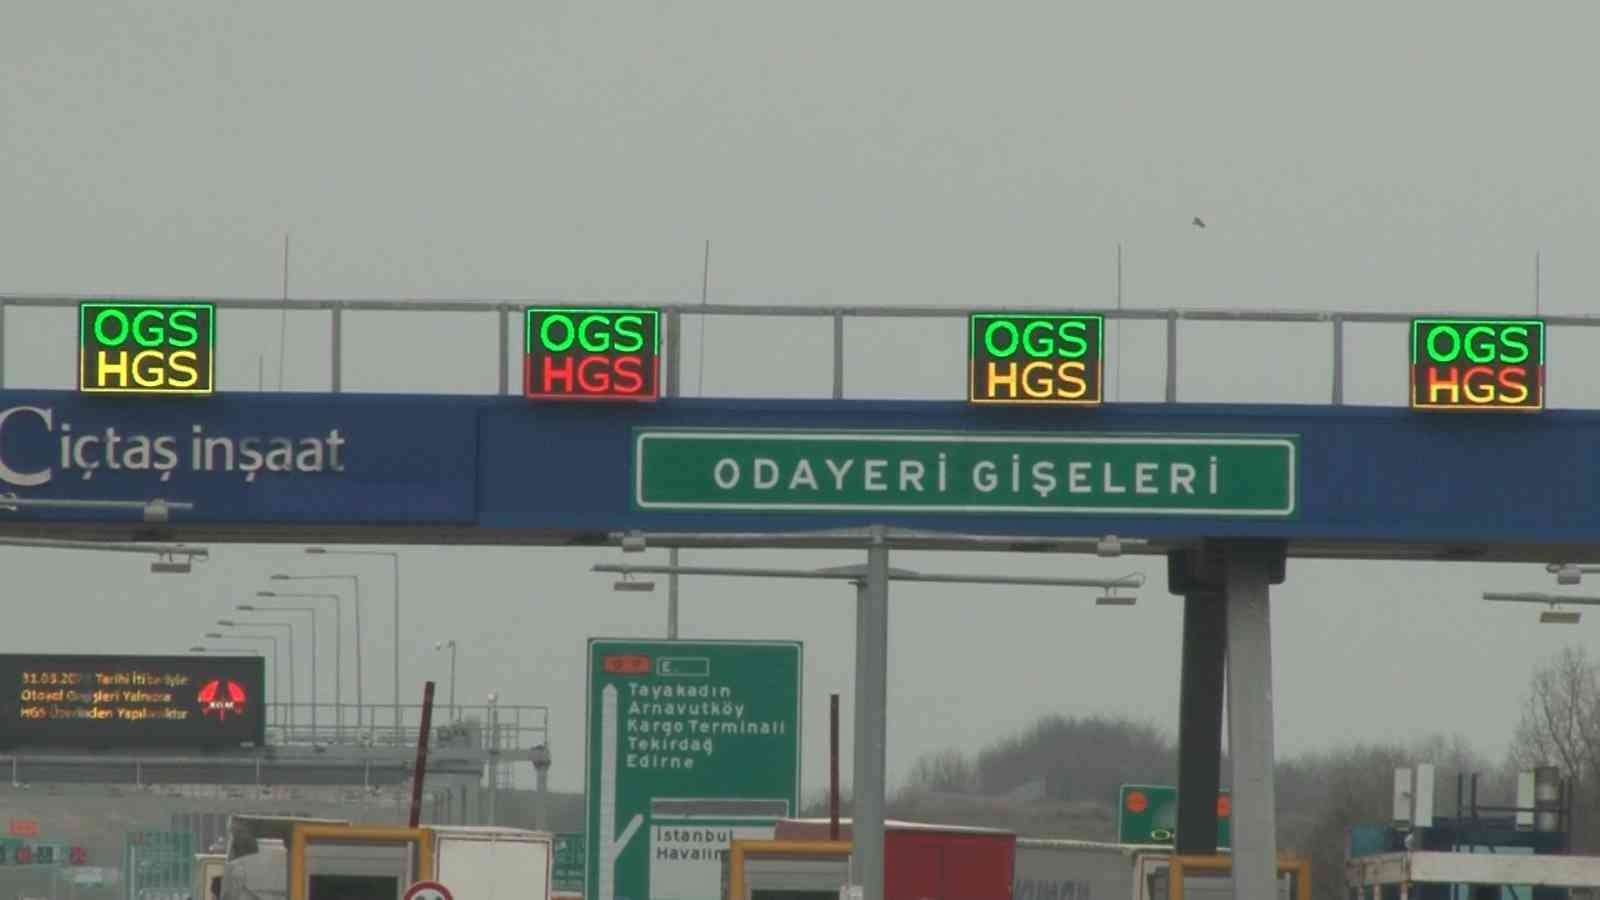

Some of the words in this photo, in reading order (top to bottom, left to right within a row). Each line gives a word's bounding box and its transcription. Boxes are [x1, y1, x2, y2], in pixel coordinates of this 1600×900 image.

[94, 309, 198, 347] OGS
[540, 314, 644, 352] OGS
[985, 320, 1087, 357] OGS
[1427, 326, 1529, 363] OGS
[97, 350, 198, 387] HGS
[543, 355, 643, 393] HGS
[988, 361, 1087, 398] HGS
[1429, 366, 1528, 404] HGS
[60, 422, 178, 482] içtaş
[191, 424, 345, 483] inşaat
[713, 452, 947, 491] ODAYERİ
[972, 453, 1218, 498] GİŞELERİ
[628, 682, 731, 700] Tayakadın
[628, 701, 745, 718] Arnavutköy
[627, 719, 683, 737] Kargo
[688, 720, 785, 736] Terminali
[628, 735, 713, 756] Tekirdağ
[626, 753, 694, 768] Edirne
